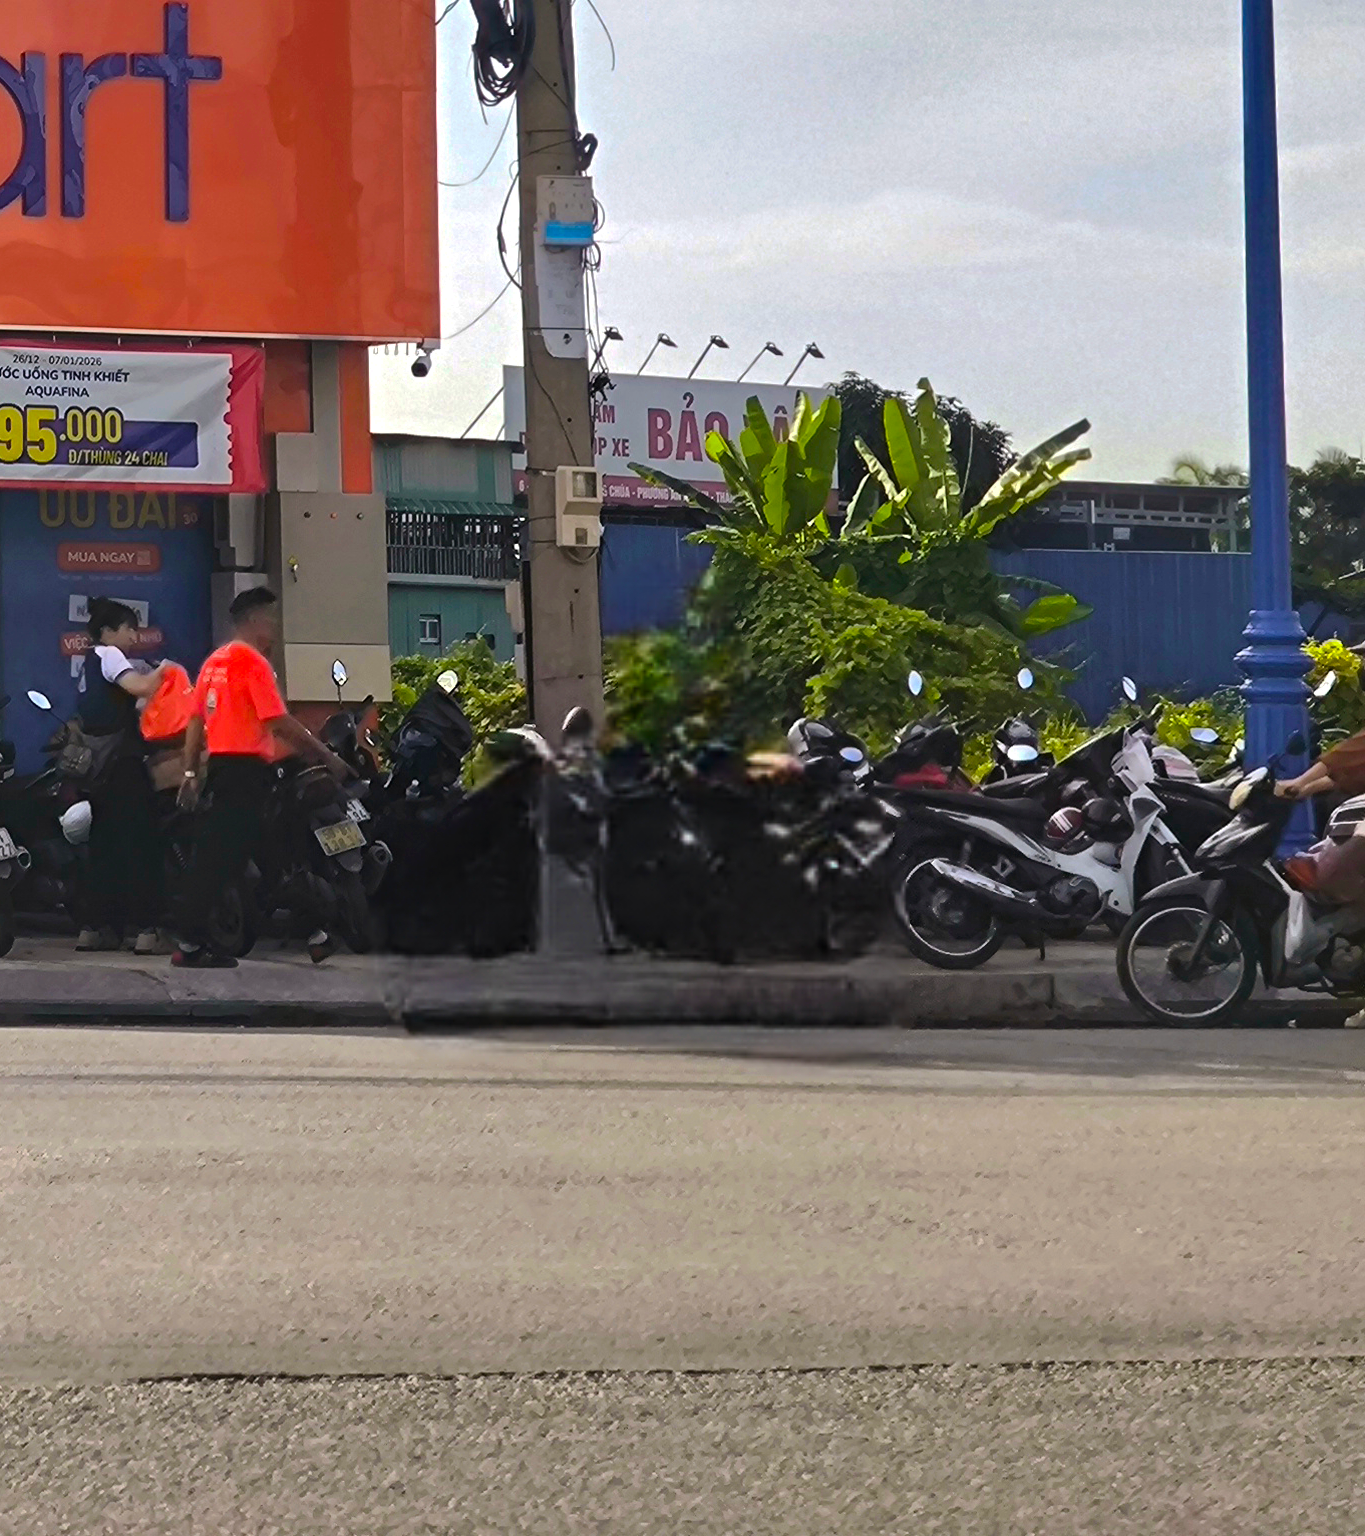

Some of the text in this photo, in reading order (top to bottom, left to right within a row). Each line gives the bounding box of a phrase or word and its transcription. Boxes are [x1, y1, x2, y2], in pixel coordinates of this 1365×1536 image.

[13, 354, 40, 364] 26/12
[48, 355, 103, 366] 07/01/2026
[22, 364, 59, 381] UỐNG
[61, 370, 91, 382] TINH
[94, 368, 130, 383] KHIẾT
[25, 385, 90, 398] AQUAFINA
[647, 391, 730, 463] BẢO
[68, 446, 168, 466] Đ/THÙNG 24 CHAI
[612, 437, 630, 458] XE
[67, 551, 136, 564] MUA NGAY
